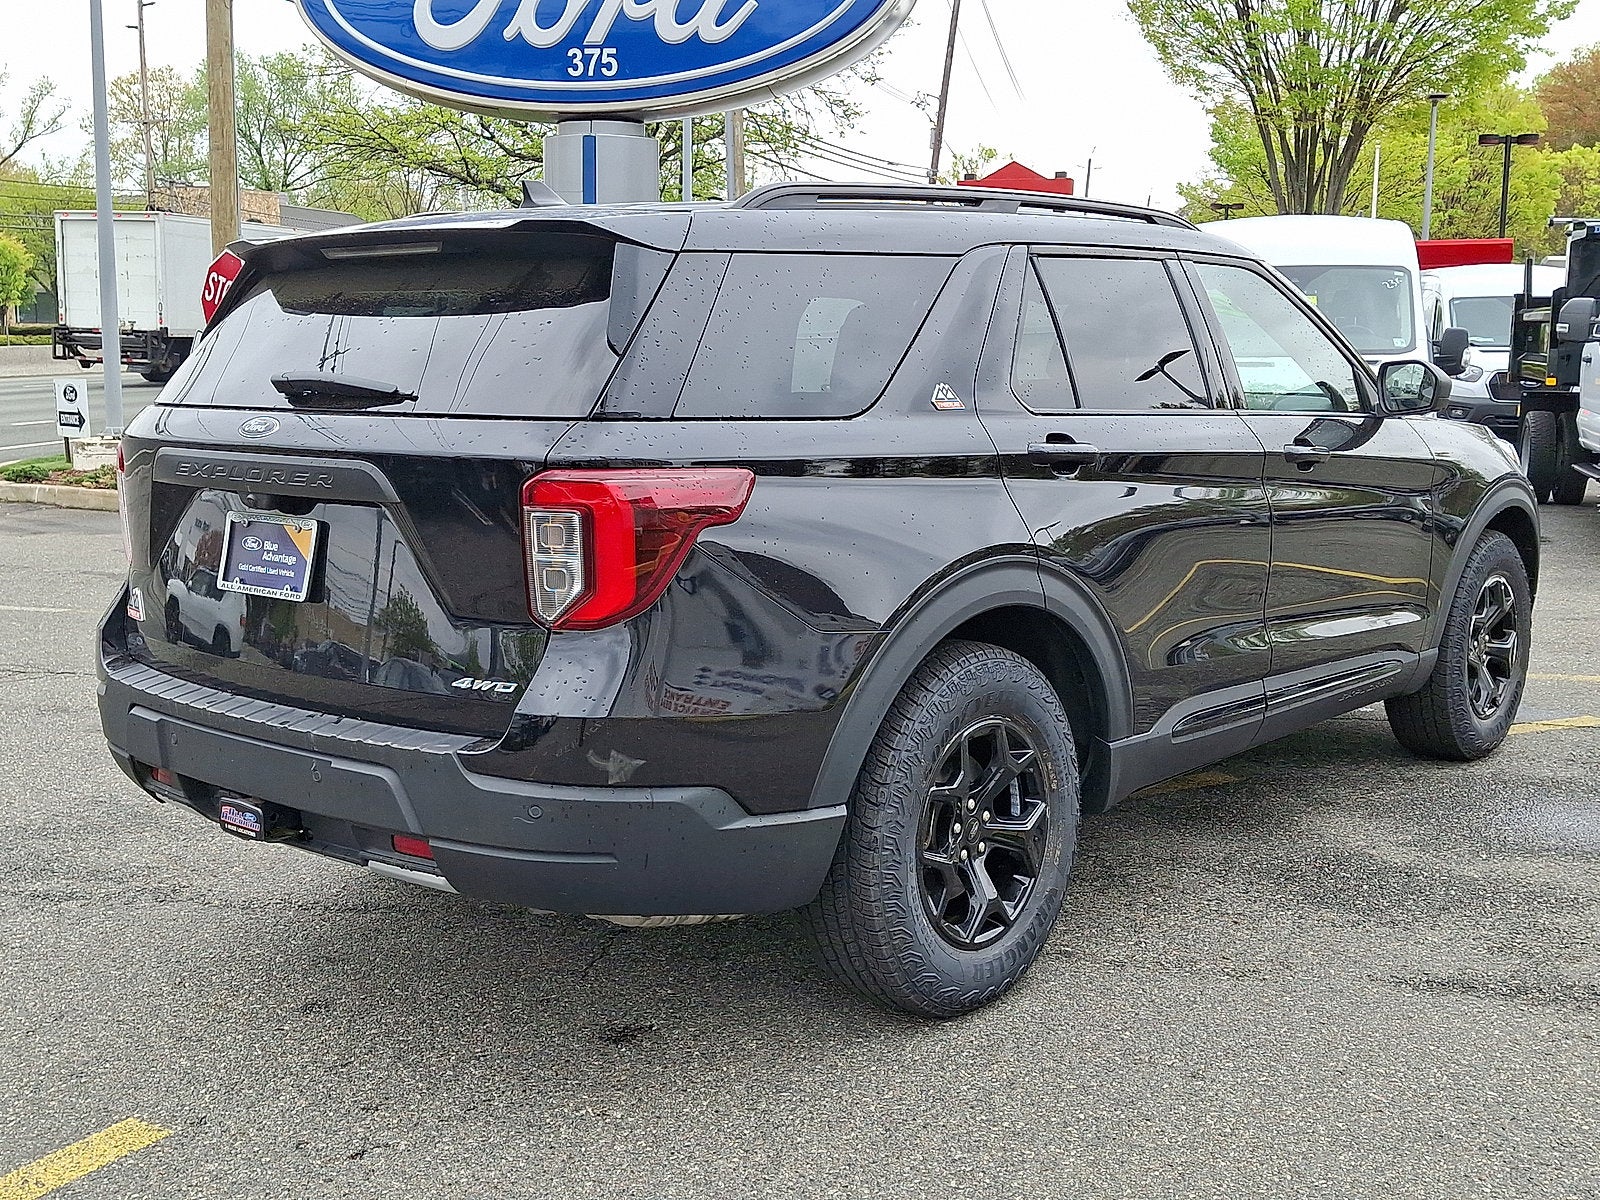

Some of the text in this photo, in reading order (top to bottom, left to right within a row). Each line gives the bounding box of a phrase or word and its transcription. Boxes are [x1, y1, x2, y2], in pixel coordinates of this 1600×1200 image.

[566, 48, 619, 77] 375
[204, 271, 234, 305] ST
[175, 461, 334, 489] EXPLORER
[263, 540, 279, 551] Blue
[262, 551, 297, 565] Advantage
[238, 563, 249, 571] Gold
[248, 565, 267, 573] Certified
[236, 585, 278, 596] AMERICAN
[279, 592, 301, 600] FORD
[451, 677, 519, 693] 4WD
[972, 886, 1060, 984] WRANGLER
